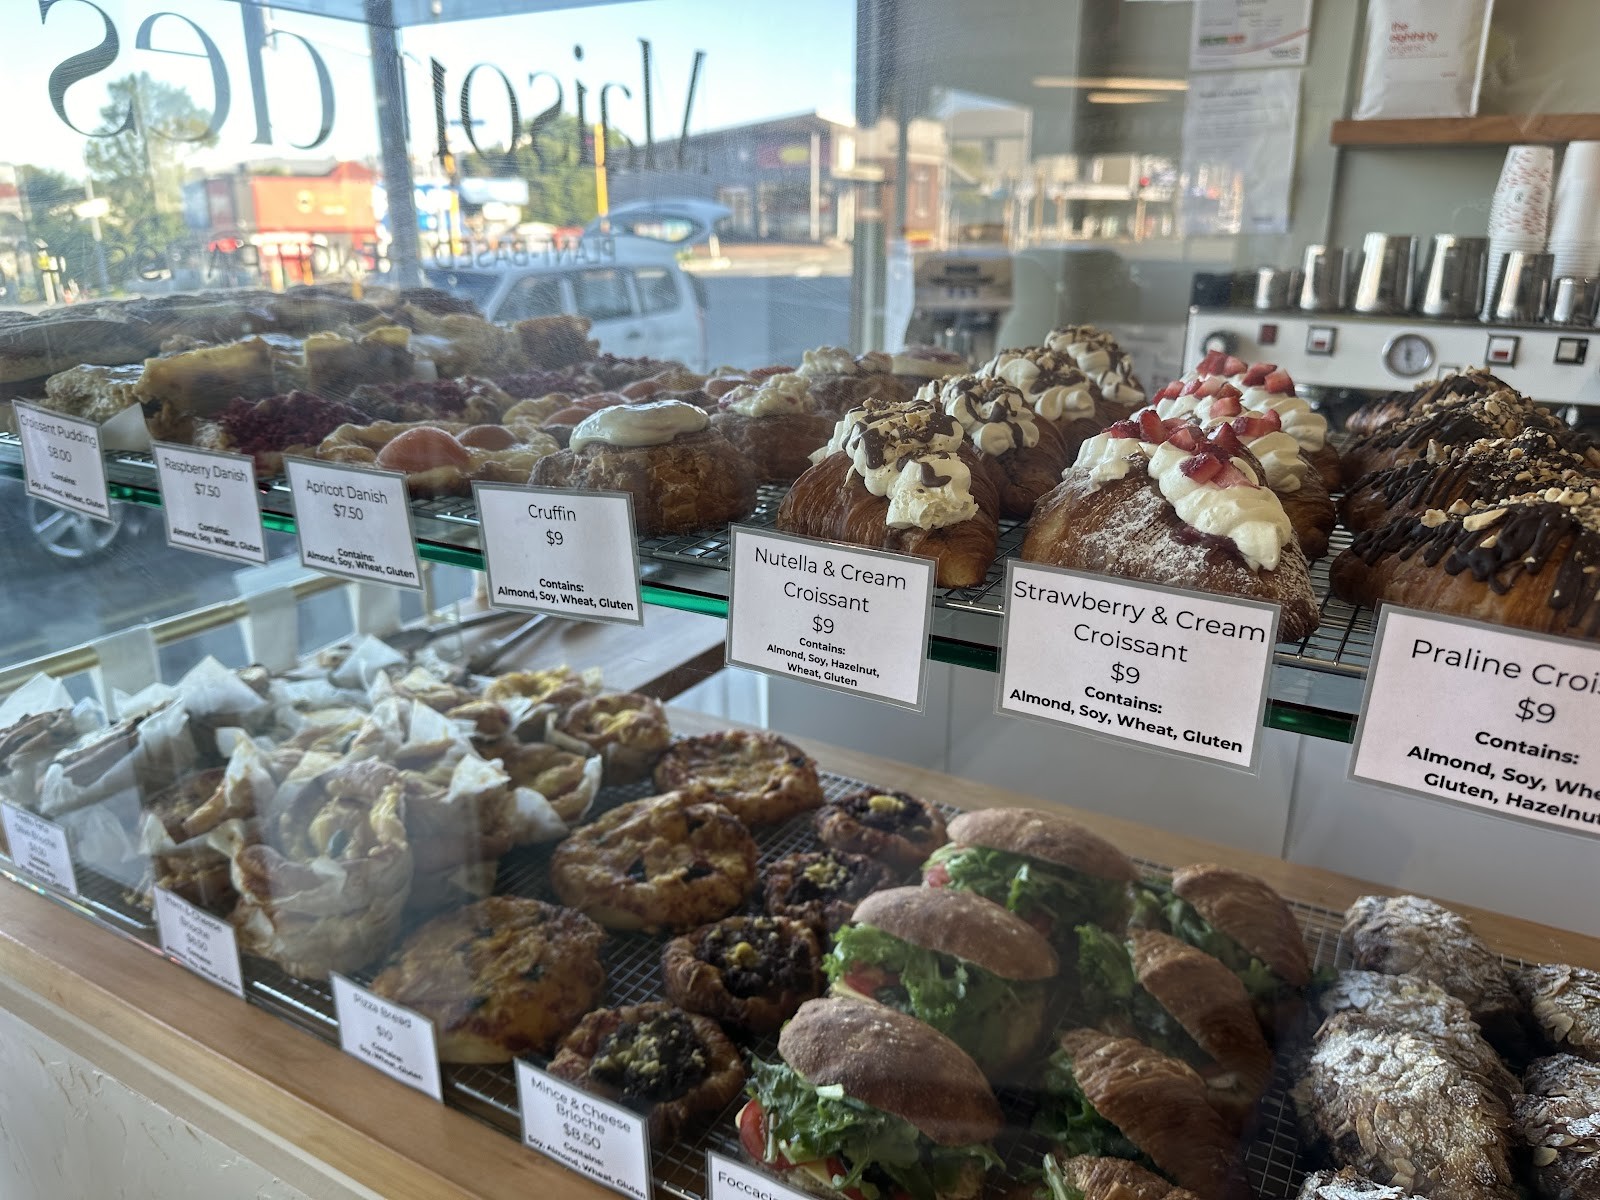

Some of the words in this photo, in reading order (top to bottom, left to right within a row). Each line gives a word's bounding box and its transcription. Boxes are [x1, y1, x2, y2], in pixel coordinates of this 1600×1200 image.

[20, 414, 56, 436] Croissant
[57, 425, 97, 449] Pudding
[47, 445, 72, 463] $8.00
[164, 457, 211, 479] Raspberry
[212, 465, 248, 482] Danish
[194, 482, 221, 498] $7.50
[306, 479, 345, 504] Apricot
[346, 485, 388, 506] Danish
[333, 502, 364, 522] $7.50
[528, 503, 577, 523] Cruffin
[545, 528, 564, 548] $9
[307, 550, 338, 566] Almond,
[338, 556, 355, 570] Soy,
[355, 560, 386, 575] Wheat,
[386, 565, 415, 580] Gluten
[337, 547, 375, 563] Contains:
[755, 547, 817, 574] Nutella
[823, 560, 836, 577] &
[840, 564, 907, 590] Cream
[498, 585, 539, 602] Almond,
[539, 590, 559, 605] Soy,
[560, 594, 597, 610] Wheat,
[599, 598, 634, 612] Gluten
[539, 578, 584, 593] Contains:
[783, 581, 870, 613] Croissant
[812, 614, 835, 635] $9
[1013, 580, 1146, 624] Strawberry
[1151, 605, 1168, 626] &
[1176, 610, 1266, 643] Cream
[799, 637, 846, 655] Contains:
[1073, 623, 1188, 663] Croissant
[766, 643, 806, 663] Almond,
[808, 653, 829, 669] Soy,
[830, 658, 880, 678] Hazelnut,
[787, 662, 822, 680] Wheat,
[823, 670, 858, 687] Gluten
[1110, 660, 1140, 685] $9
[1411, 639, 1522, 679] Praline
[1531, 663, 1600, 695] Croi
[1084, 685, 1163, 714] Contains:
[1515, 696, 1556, 724] $9
[1009, 688, 1076, 715] Almond,
[1079, 703, 1112, 726] Soy,
[1116, 713, 1178, 741] Wheat,
[1182, 729, 1243, 753] Gluten
[1474, 731, 1580, 765] Contains:
[1406, 745, 1496, 780] Almond,
[1501, 766, 1547, 792] Soy,
[1423, 772, 1499, 804] Gluten,
[353, 992, 379, 1013] Pizza
[380, 1006, 412, 1028] Bread
[531, 1077, 568, 1104] Mince
[570, 1097, 579, 1110] &
[582, 1103, 631, 1133] Cheese
[556, 1102, 605, 1135] Brioche
[563, 1122, 601, 1150] $8.50
[528, 1134, 546, 1149] Soy,
[547, 1144, 580, 1168] Almond,
[582, 1163, 615, 1184] Wheat,
[617, 1178, 646, 1199] Gluten
[563, 1142, 604, 1167] Contains:
[718, 1170, 778, 1200] Foccaci
